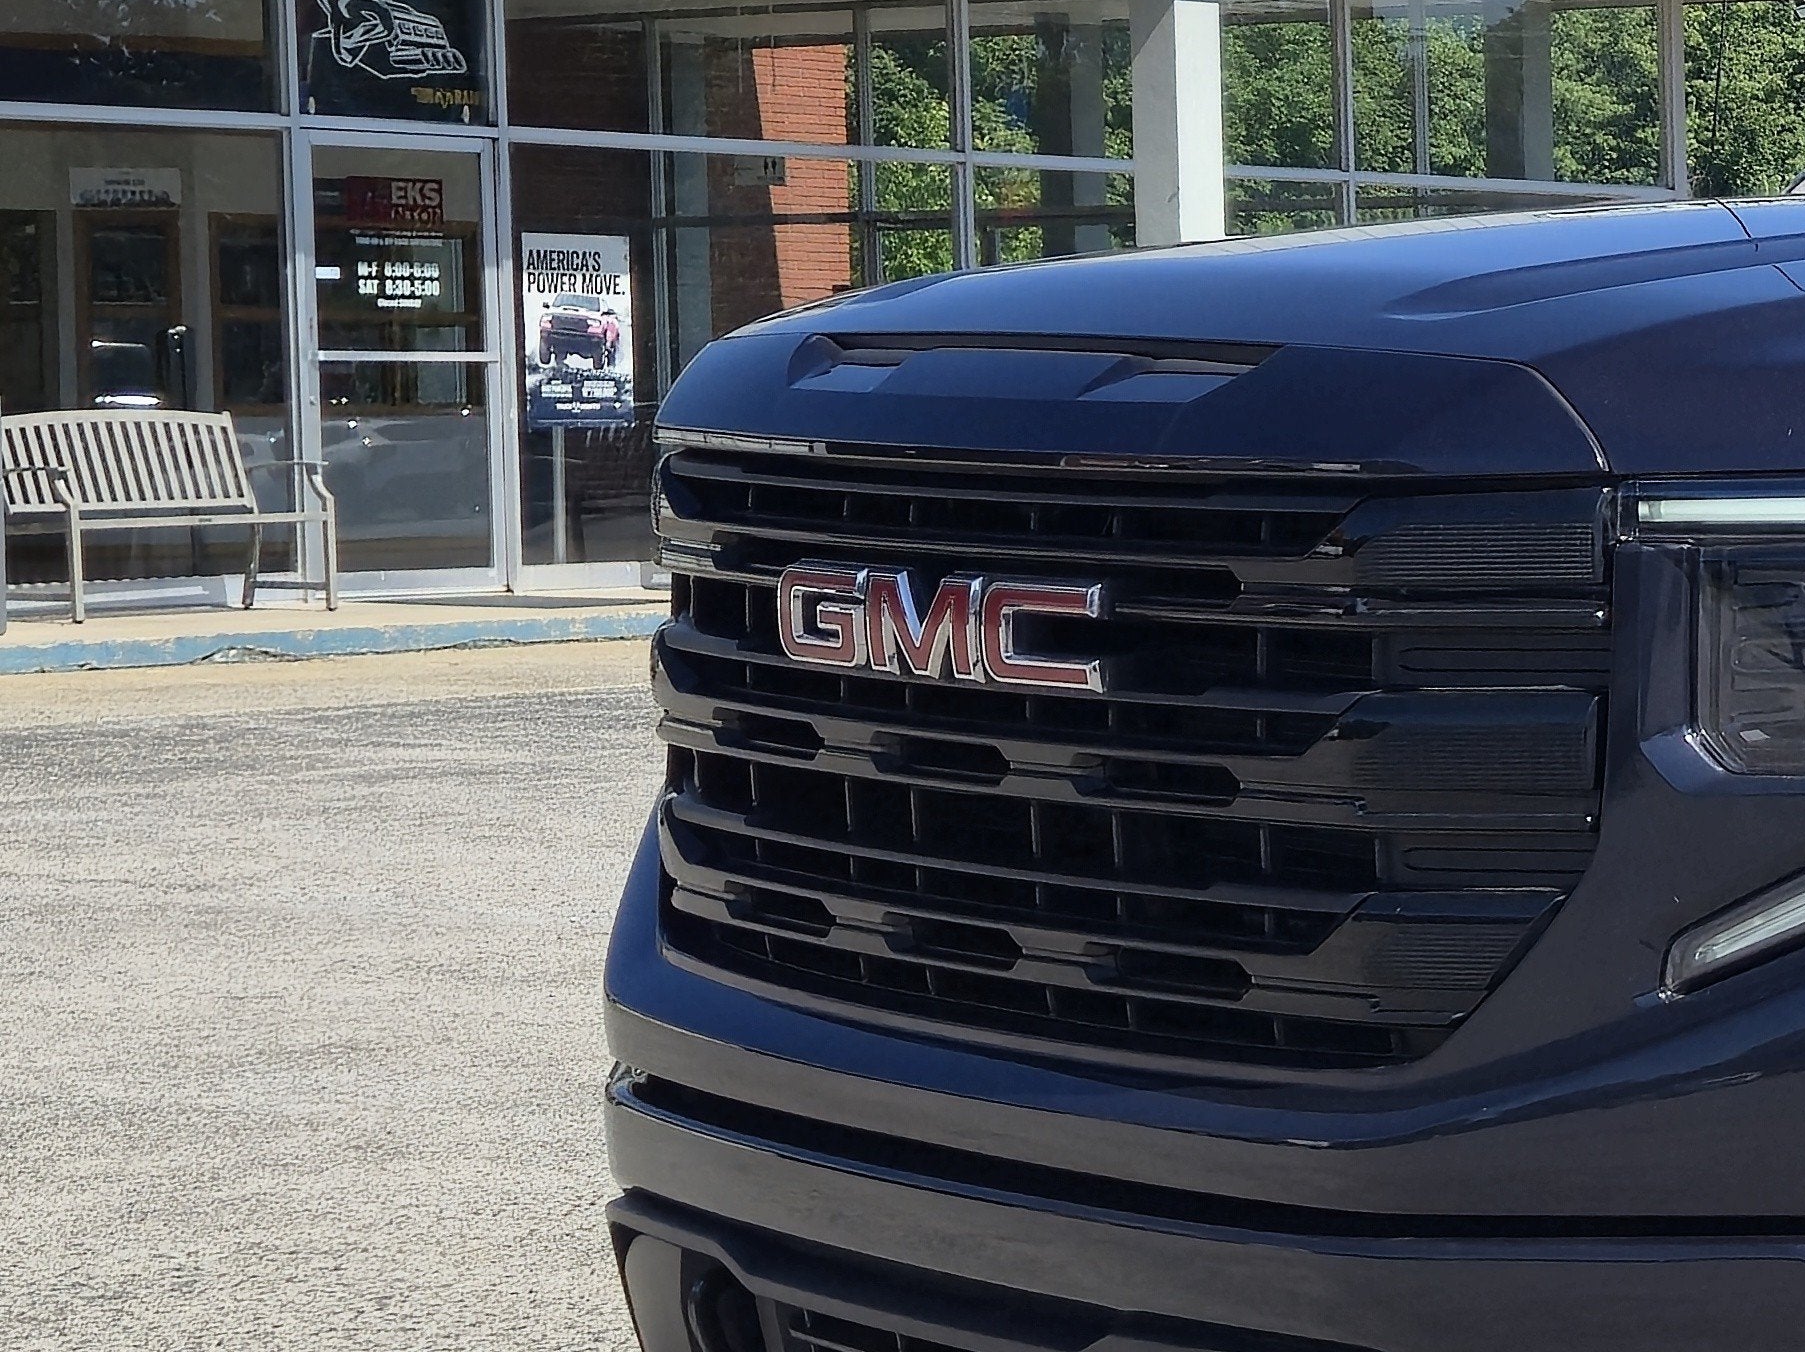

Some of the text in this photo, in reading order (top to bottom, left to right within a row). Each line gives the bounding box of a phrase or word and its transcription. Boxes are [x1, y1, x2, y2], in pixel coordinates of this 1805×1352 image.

[526, 249, 601, 273] AMERICA'S
[527, 272, 626, 296] POWER MOVE.
[778, 558, 1105, 694] GMC
